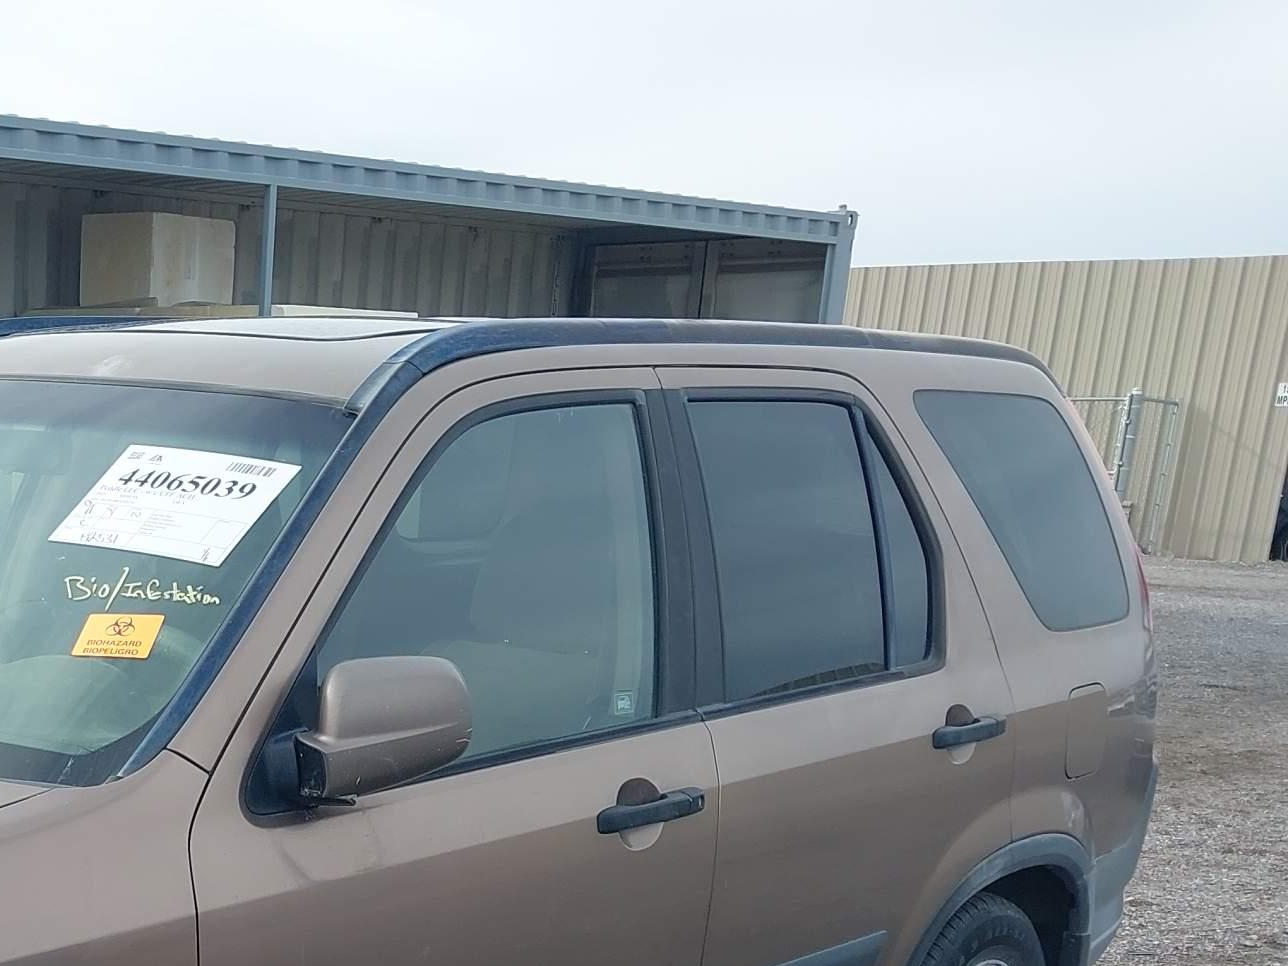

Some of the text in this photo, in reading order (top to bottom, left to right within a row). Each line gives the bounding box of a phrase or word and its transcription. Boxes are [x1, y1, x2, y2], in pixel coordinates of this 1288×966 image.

[117, 467, 258, 500] 44065039
[86, 639, 142, 647] BIOHAZARD
[82, 647, 139, 655] BIOPELIGRO
